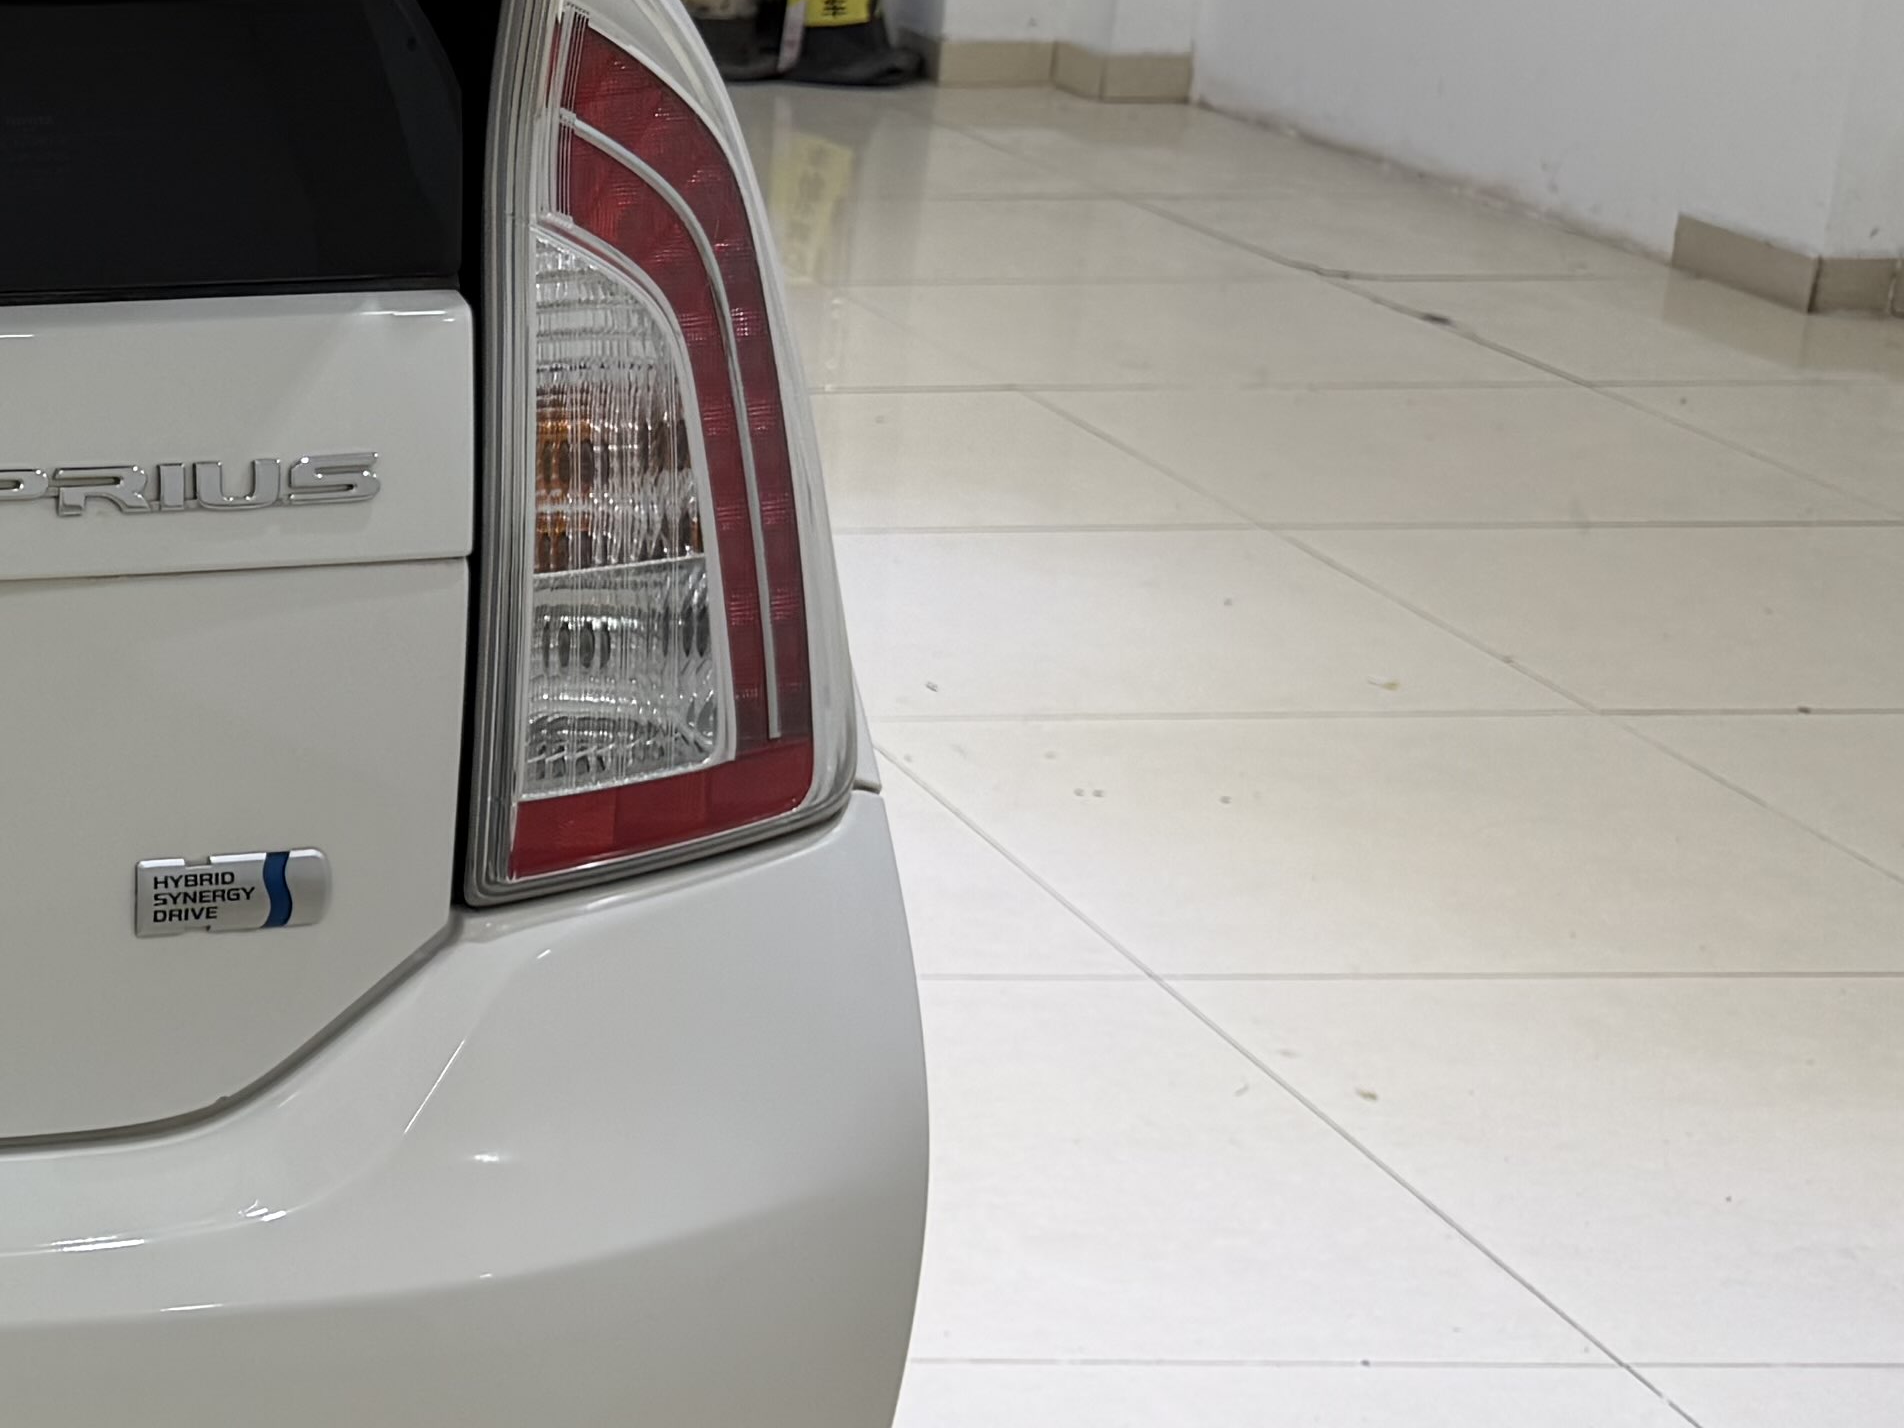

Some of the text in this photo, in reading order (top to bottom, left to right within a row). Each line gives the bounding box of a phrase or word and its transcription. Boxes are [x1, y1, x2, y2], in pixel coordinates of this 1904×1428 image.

[153, 871, 235, 890] HYBRID
[153, 887, 256, 906] SYNERGY
[153, 906, 218, 924] DRIVE
